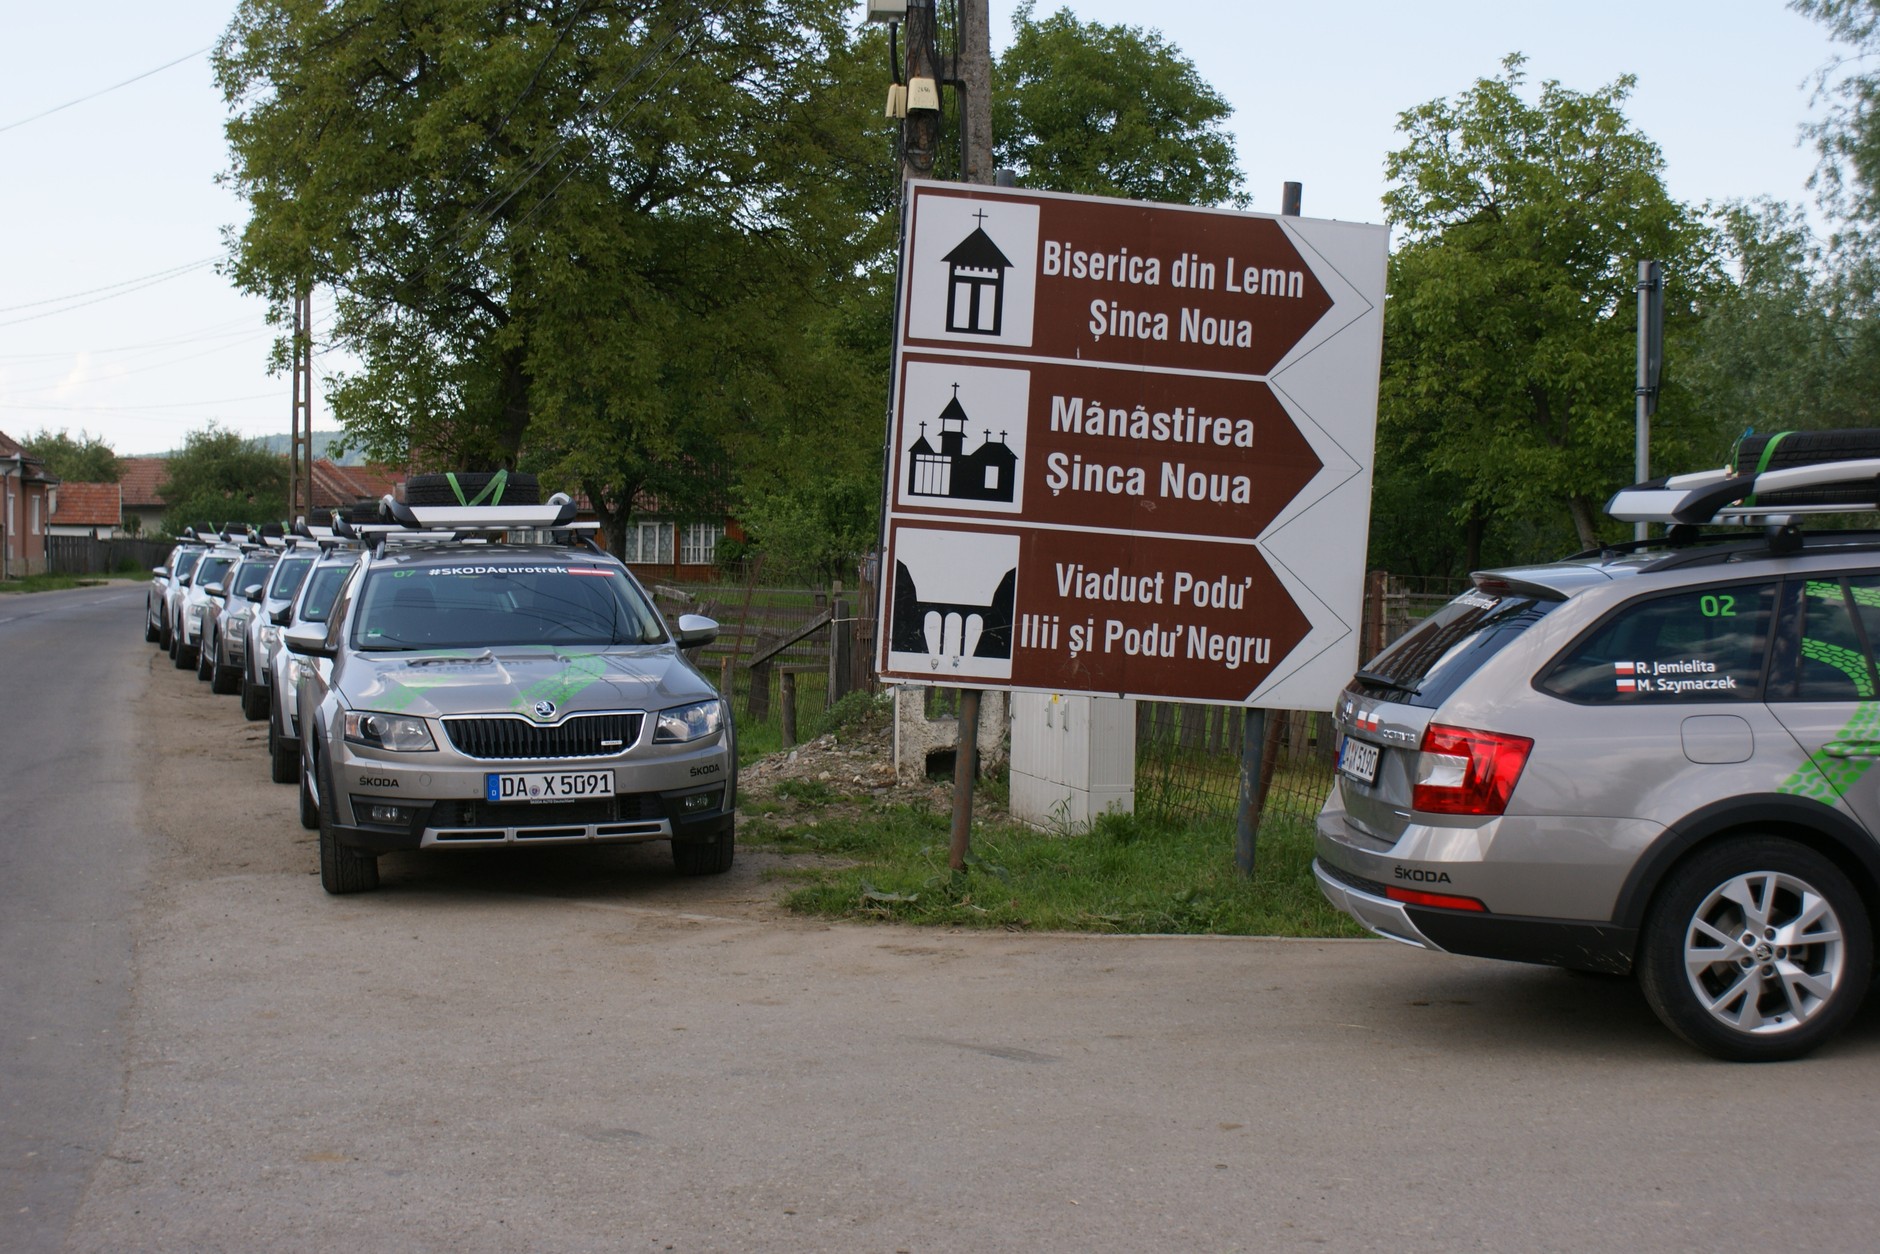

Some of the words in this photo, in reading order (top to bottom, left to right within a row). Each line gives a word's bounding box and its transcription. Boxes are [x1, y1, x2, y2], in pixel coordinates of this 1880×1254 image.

[1043, 240, 1161, 286] Biserica
[1171, 253, 1216, 290] din
[1226, 257, 1304, 298] Lemn
[1089, 299, 1169, 342] Șinca
[1180, 307, 1252, 348] Noua
[1046, 452, 1146, 497] Șinca
[1160, 462, 1251, 504] Noua
[393, 570, 416, 578] 07
[429, 565, 568, 576] #SKODAeurotrek
[1055, 562, 1164, 604] Viaduct
[1174, 571, 1252, 610] Podu'
[1700, 595, 1737, 617] 02
[1020, 613, 1059, 650] Ilii
[1068, 618, 1094, 659] și
[1186, 625, 1271, 669] Negru
[1636, 662, 1650, 674] R.
[1653, 660, 1716, 676] Jemielita
[1637, 679, 1654, 692] M.
[1657, 676, 1736, 693] Szymaczek
[359, 775, 399, 788] ŠKODA
[690, 764, 720, 777] ŠKODA
[501, 777, 528, 797] DA
[543, 776, 556, 796] X
[560, 774, 611, 795] 5091
[1394, 864, 1452, 884] ŠKODA
